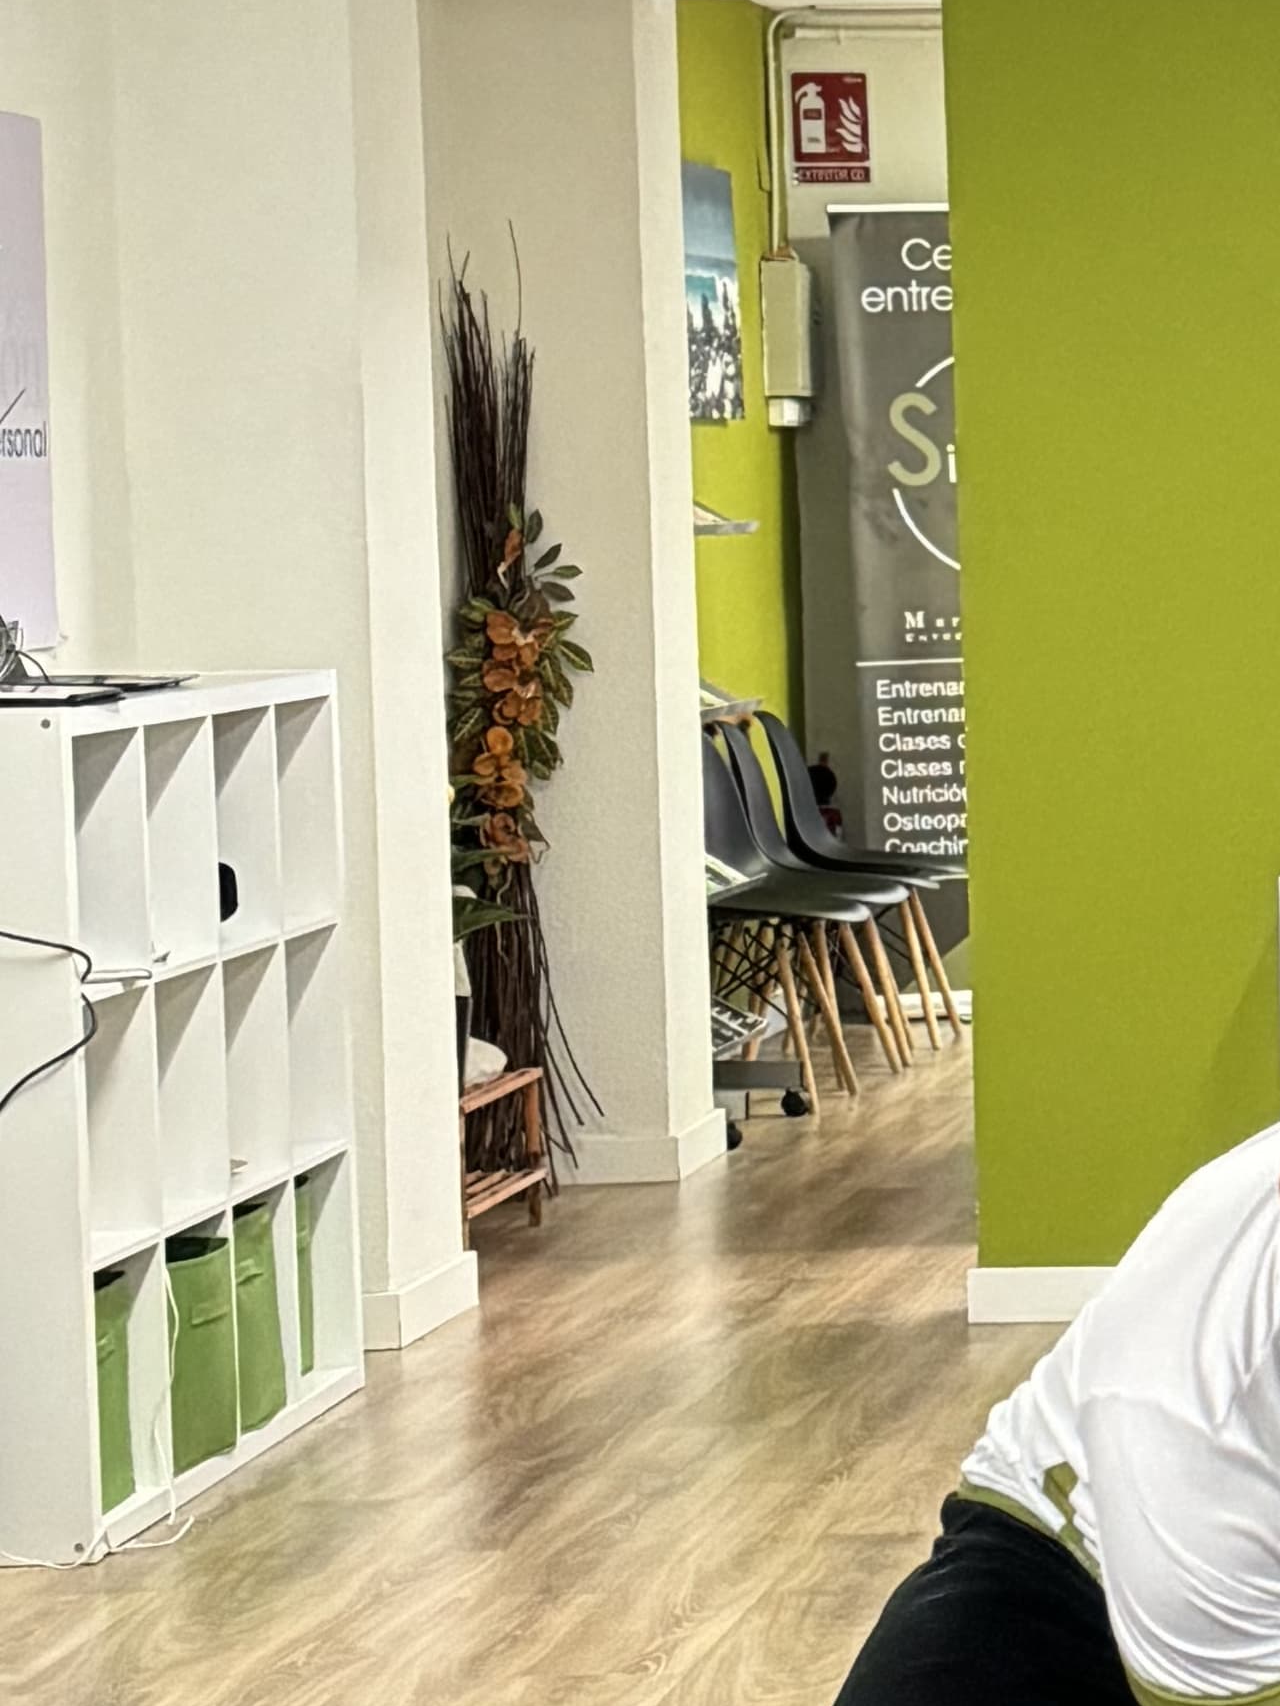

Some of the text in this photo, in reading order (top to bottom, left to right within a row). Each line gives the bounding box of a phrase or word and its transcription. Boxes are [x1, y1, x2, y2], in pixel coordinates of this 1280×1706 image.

[901, 237, 952, 271] Ce
[861, 279, 953, 313] entre
[0, 421, 47, 458] rsonal
[888, 392, 957, 486] Si
[879, 733, 951, 752] Clases
[881, 759, 953, 779] Clases
